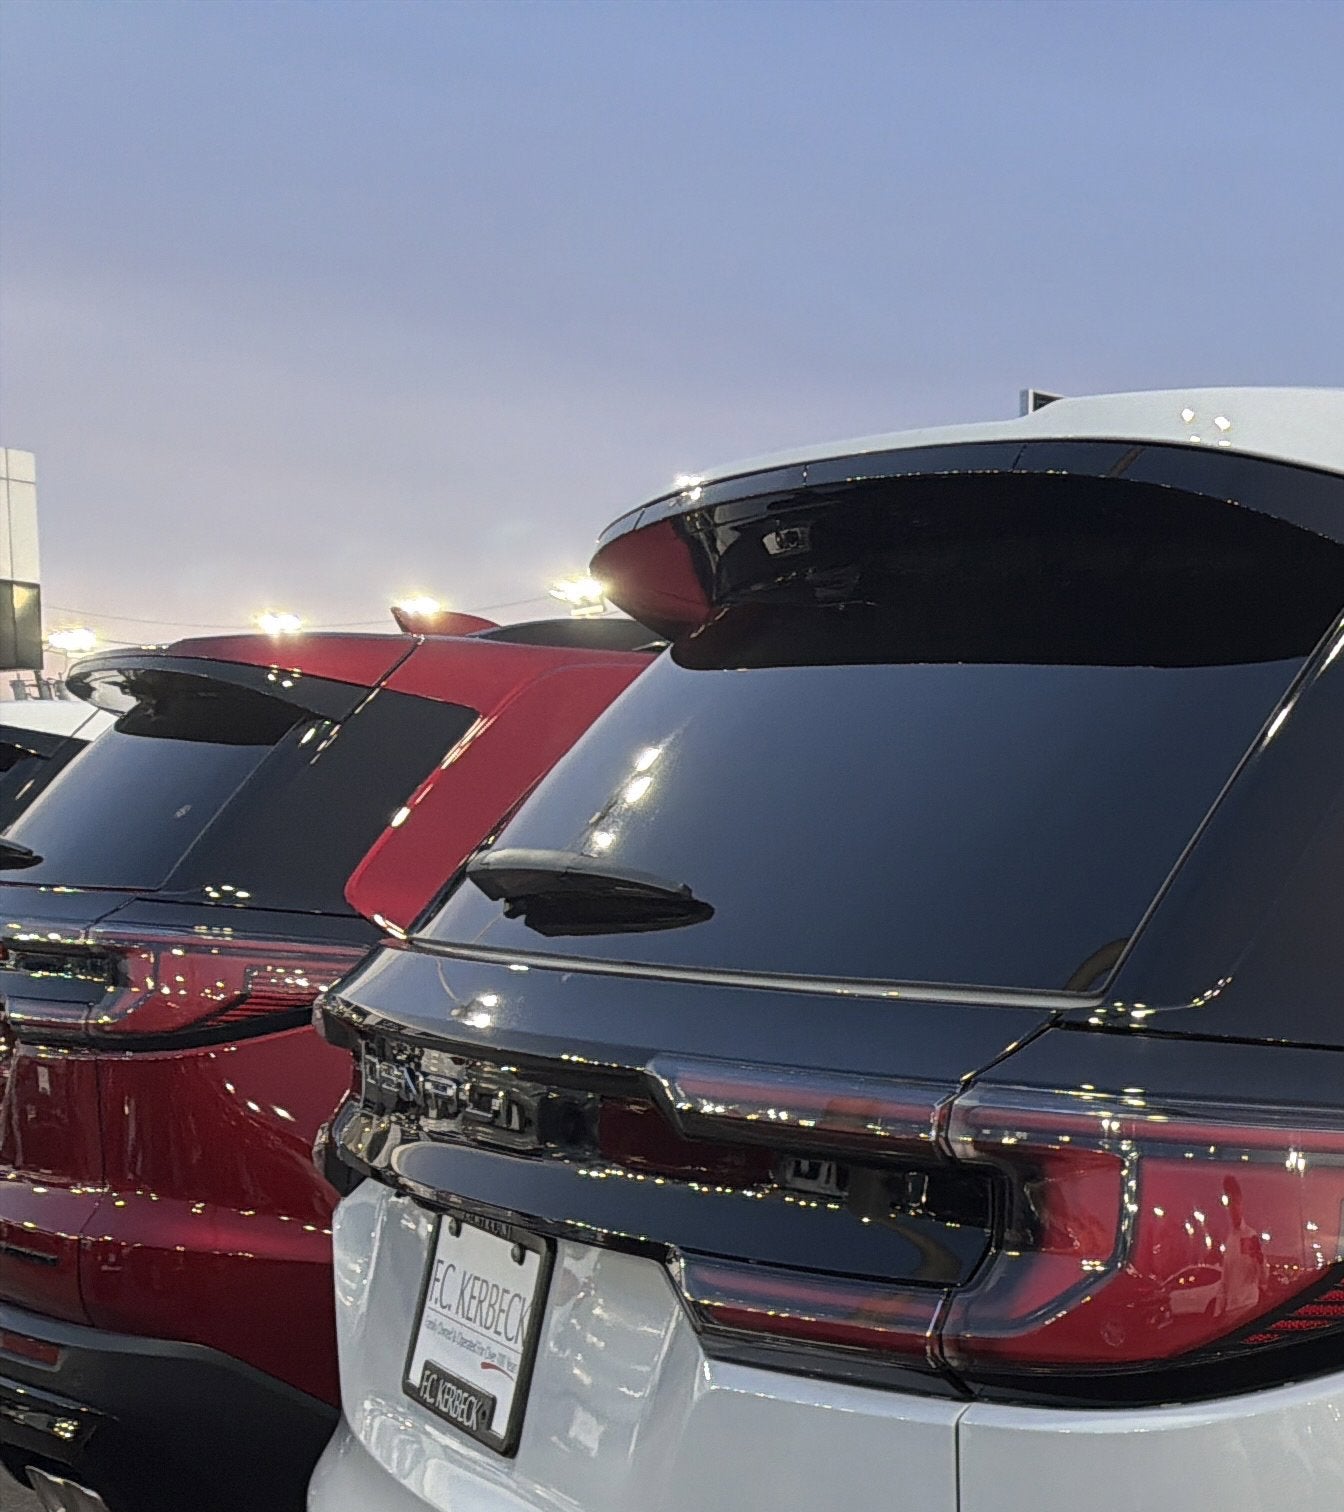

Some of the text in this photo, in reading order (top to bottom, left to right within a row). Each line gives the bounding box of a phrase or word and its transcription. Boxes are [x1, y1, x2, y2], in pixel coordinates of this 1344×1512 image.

[429, 1259, 531, 1348] F.C. KERBECK
[436, 1379, 481, 1431] KERBECK
